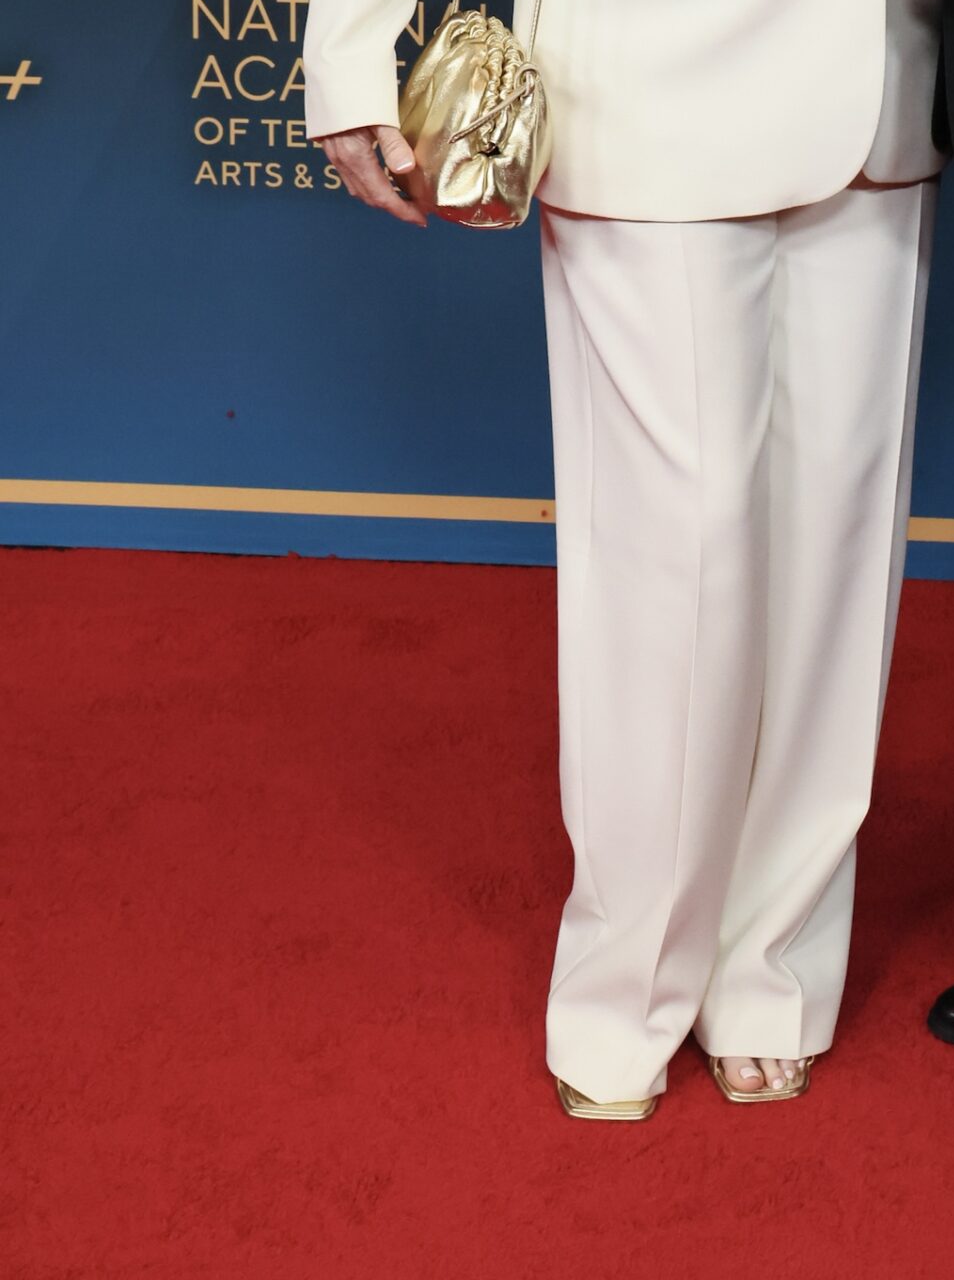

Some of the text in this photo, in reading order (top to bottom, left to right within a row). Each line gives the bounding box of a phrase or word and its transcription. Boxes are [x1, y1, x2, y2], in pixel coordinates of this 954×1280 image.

[193, 117, 250, 146] OF
[194, 160, 283, 188] ARTS
[294, 163, 314, 190] &
